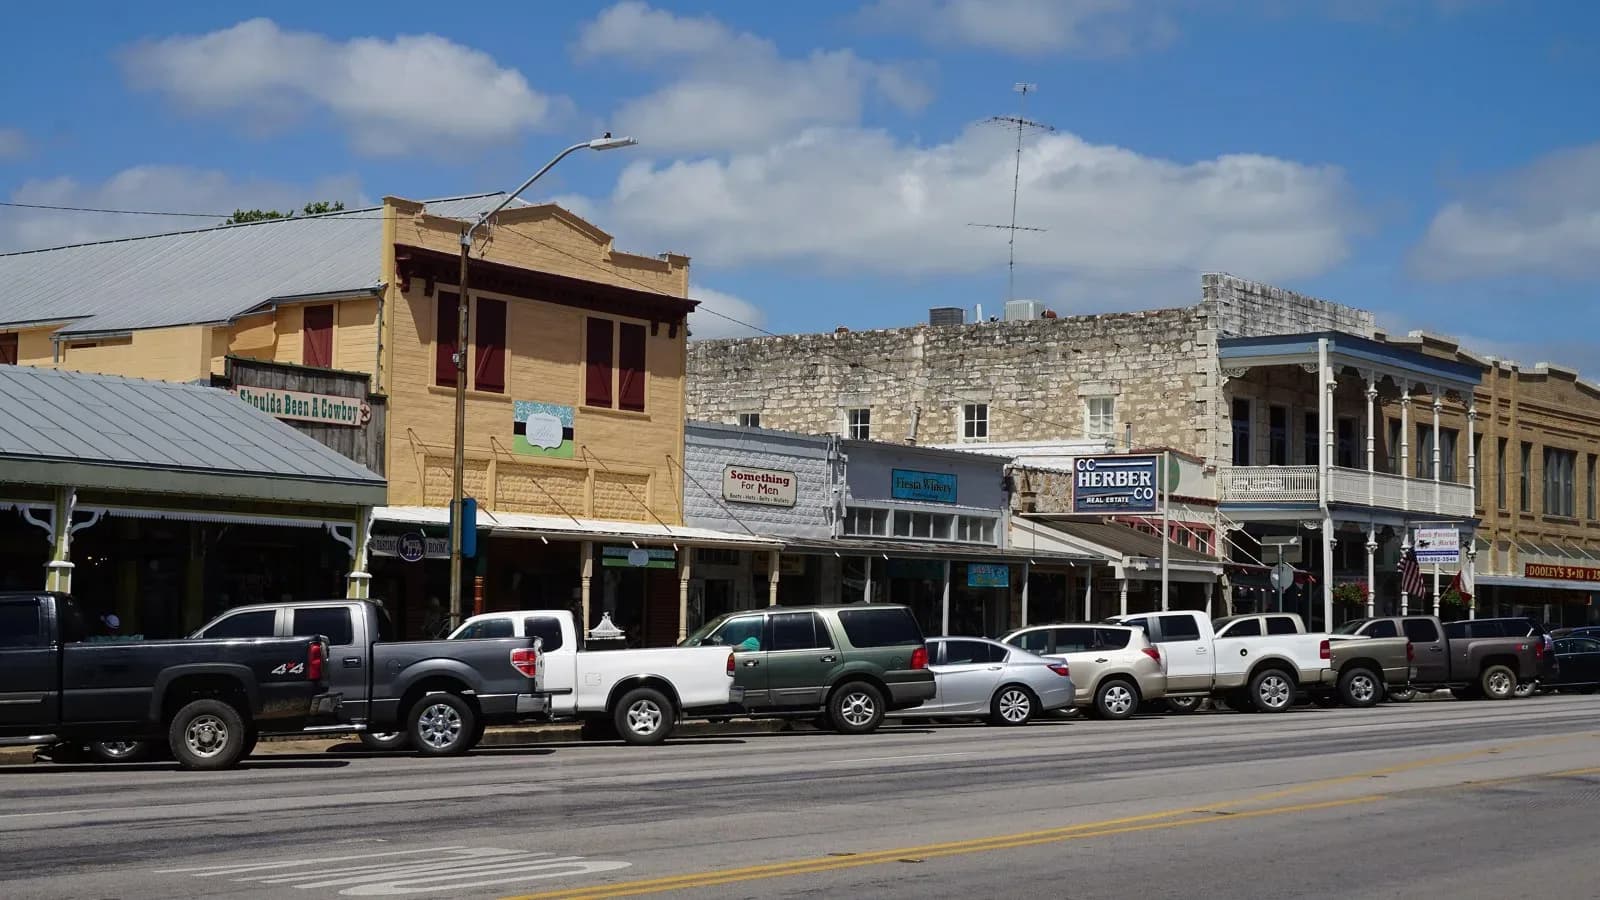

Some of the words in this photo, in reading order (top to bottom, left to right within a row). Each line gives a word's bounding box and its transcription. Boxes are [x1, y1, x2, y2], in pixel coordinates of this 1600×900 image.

[240, 389, 282, 414] Shoulda
[284, 394, 309, 416] Been
[312, 397, 319, 417] A
[321, 398, 358, 424] Cowboy
[1076, 458, 1096, 471] CC
[730, 469, 790, 488] Something
[896, 477, 920, 489] Fiesta
[923, 479, 952, 493] Winery
[1078, 471, 1152, 487] HERBER
[741, 481, 755, 490] For
[757, 483, 779, 496] Men
[1133, 487, 1154, 500] CO
[1086, 496, 1104, 504] REAL
[427, 542, 447, 553] ROOM
[1529, 565, 1565, 578] DOOLEY'S
[153, 845, 633, 896] ONLY
